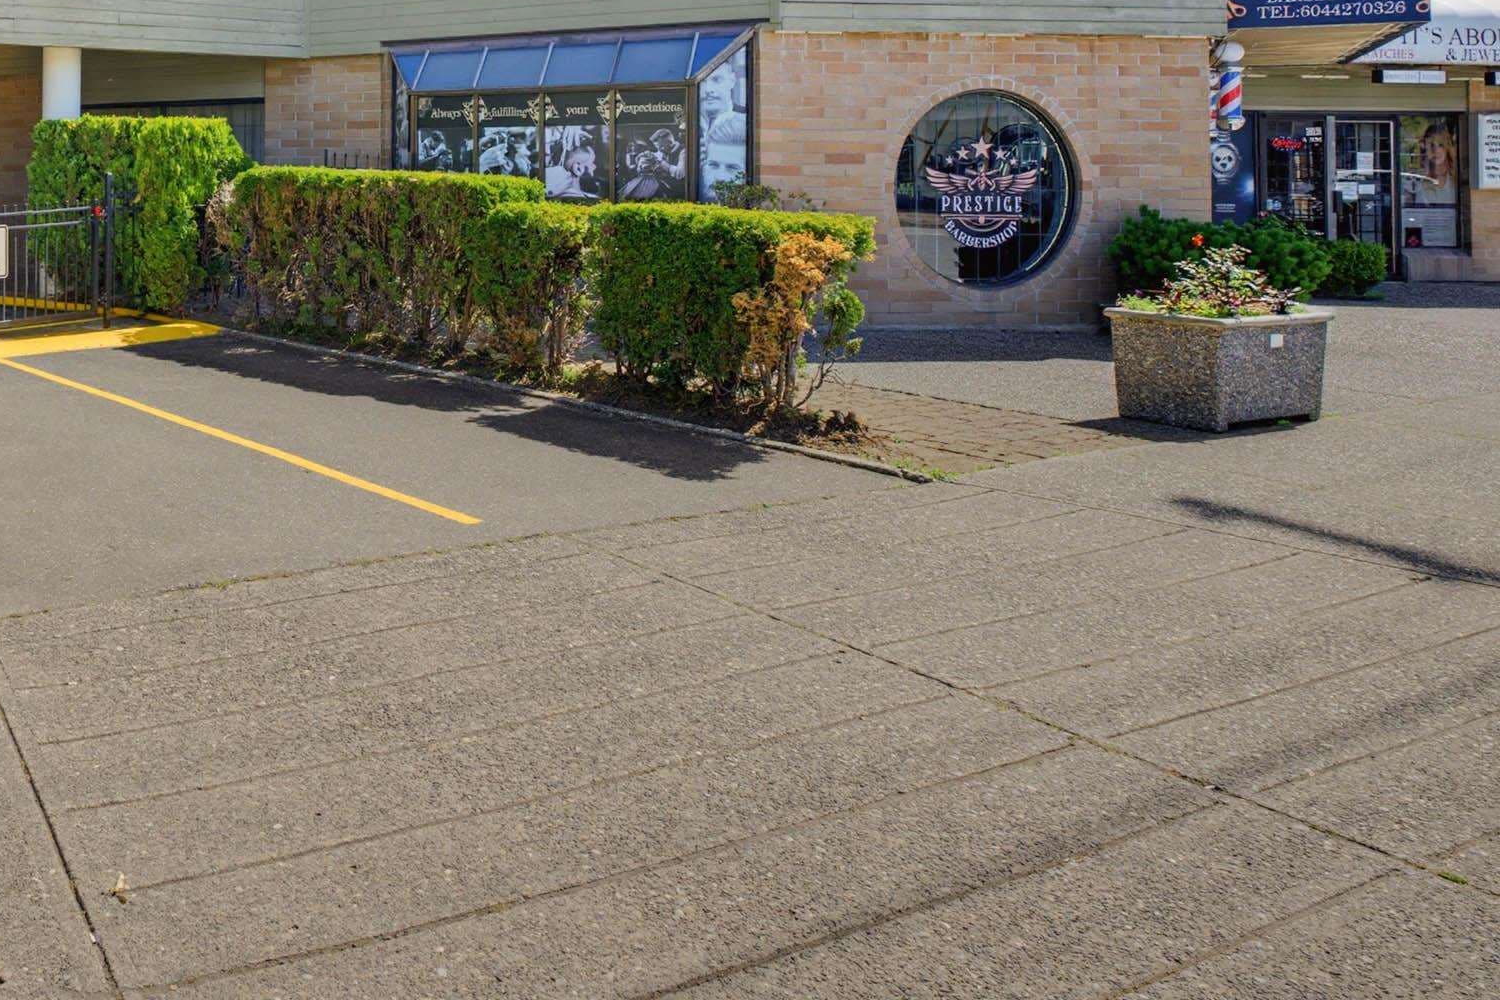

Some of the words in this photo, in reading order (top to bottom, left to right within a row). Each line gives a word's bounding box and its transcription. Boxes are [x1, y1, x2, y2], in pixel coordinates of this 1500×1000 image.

[1256, 1, 1406, 19] TEL:6044270326
[1448, 27, 1500, 46] ABO
[1445, 48, 1458, 61] &
[431, 108, 462, 119] Always
[565, 106, 590, 116] your
[623, 103, 683, 115] expectations
[941, 195, 1022, 213] PRESTIGE
[944, 220, 1017, 248] BARBERSHOP
